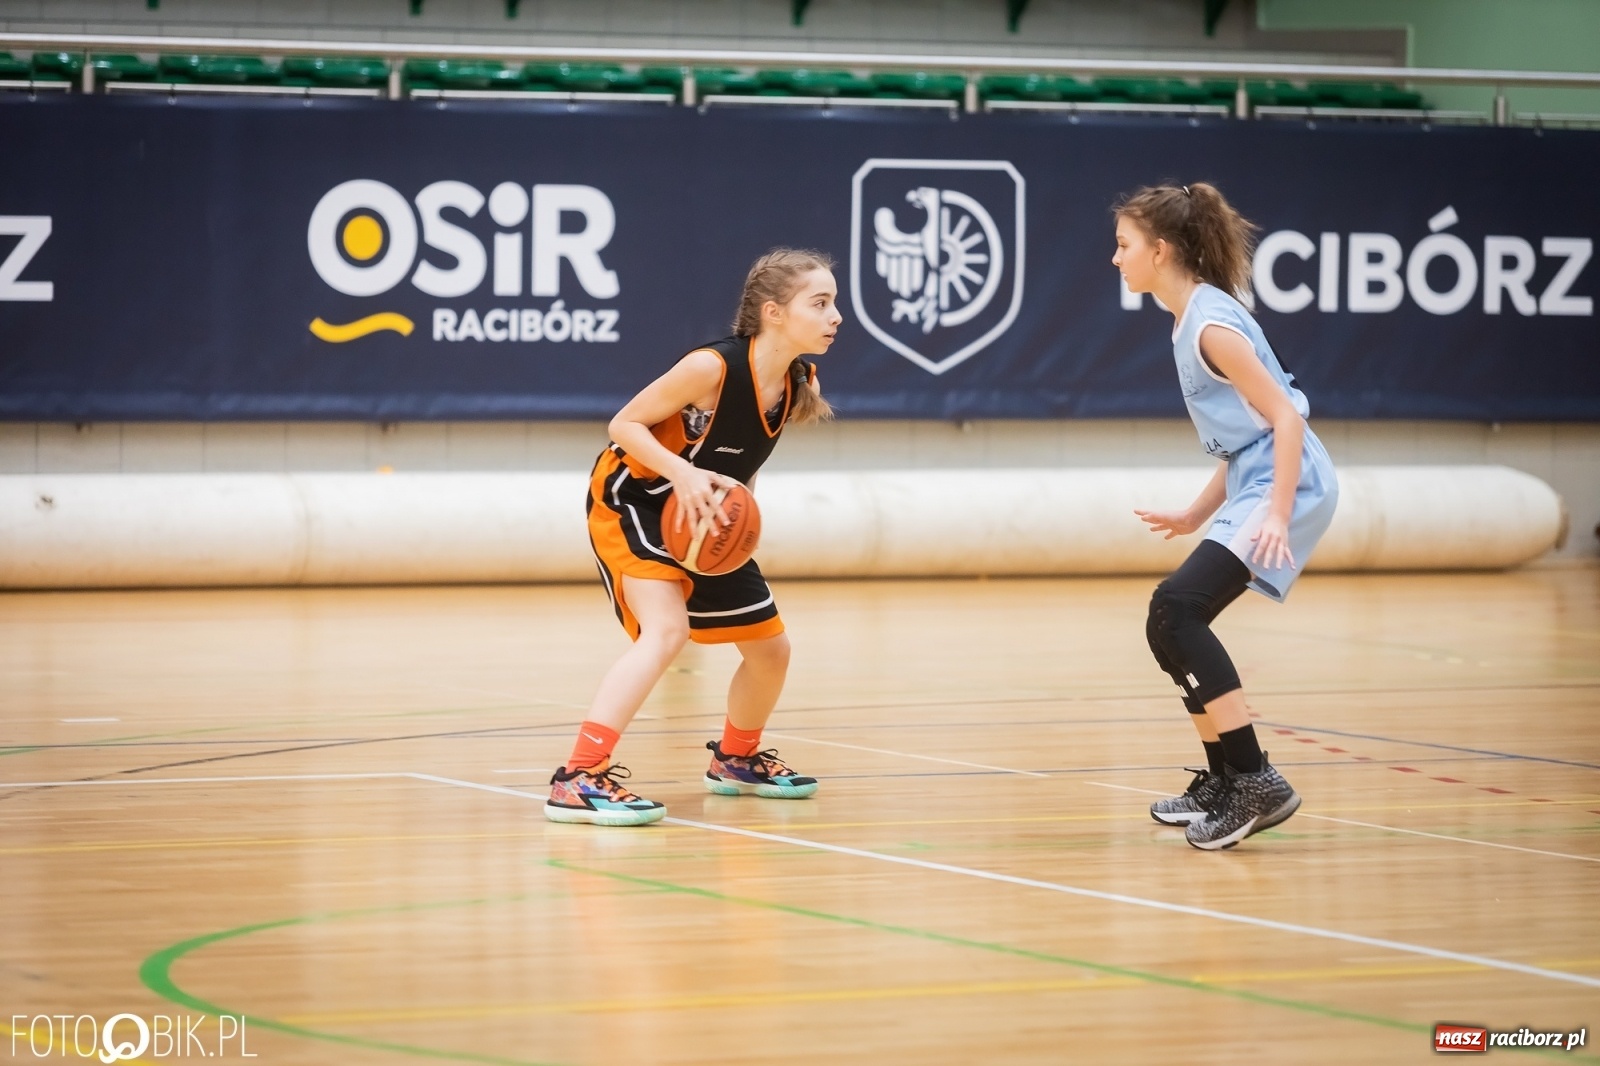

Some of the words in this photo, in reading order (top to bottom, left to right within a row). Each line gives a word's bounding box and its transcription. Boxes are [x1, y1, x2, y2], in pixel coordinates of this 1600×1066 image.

[307, 178, 620, 299] OSiR
[1121, 205, 1594, 317] CIBÓRZ
[433, 299, 620, 342] RACIBÓRZ
